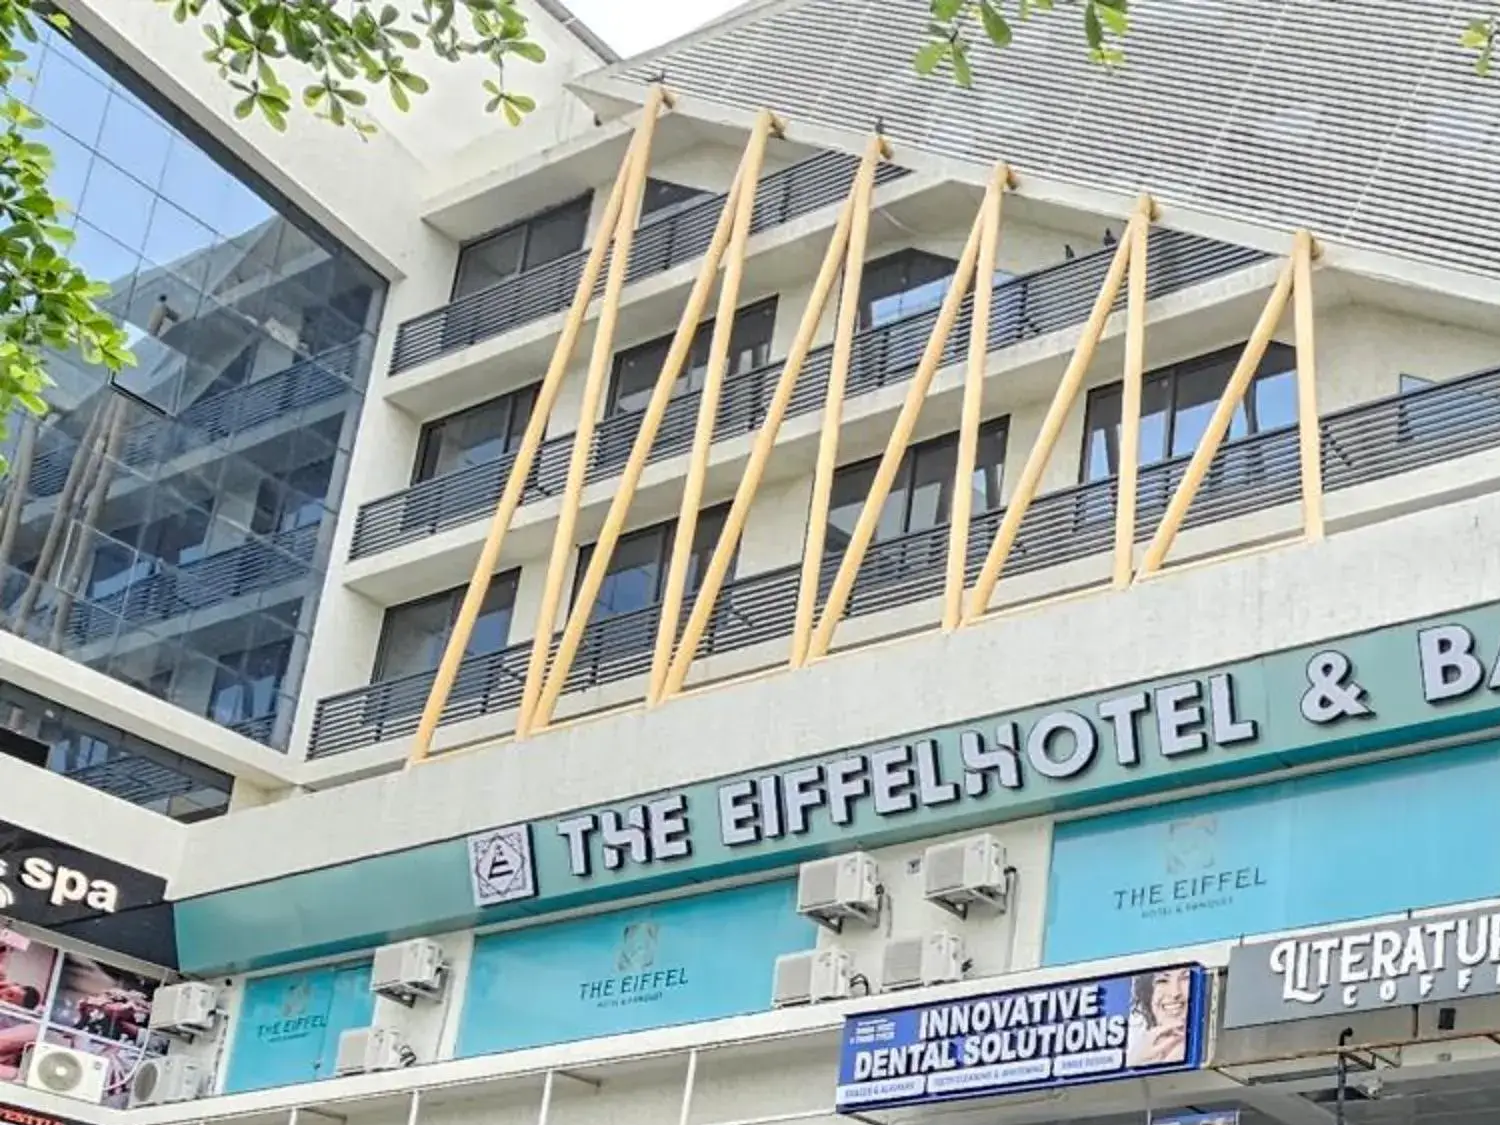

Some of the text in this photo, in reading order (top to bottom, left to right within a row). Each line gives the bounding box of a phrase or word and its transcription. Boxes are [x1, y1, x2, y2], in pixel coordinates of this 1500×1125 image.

[556, 795, 692, 877] THE
[1300, 649, 1375, 724] &
[21, 857, 118, 913] spa
[1113, 867, 1267, 910] THE EIFFEL
[580, 979, 615, 1000] THE
[620, 967, 689, 994] EIFFEL
[919, 986, 1101, 1040] INNOVATIVE
[853, 1015, 1126, 1081] DENTAL SOLUTIONS
